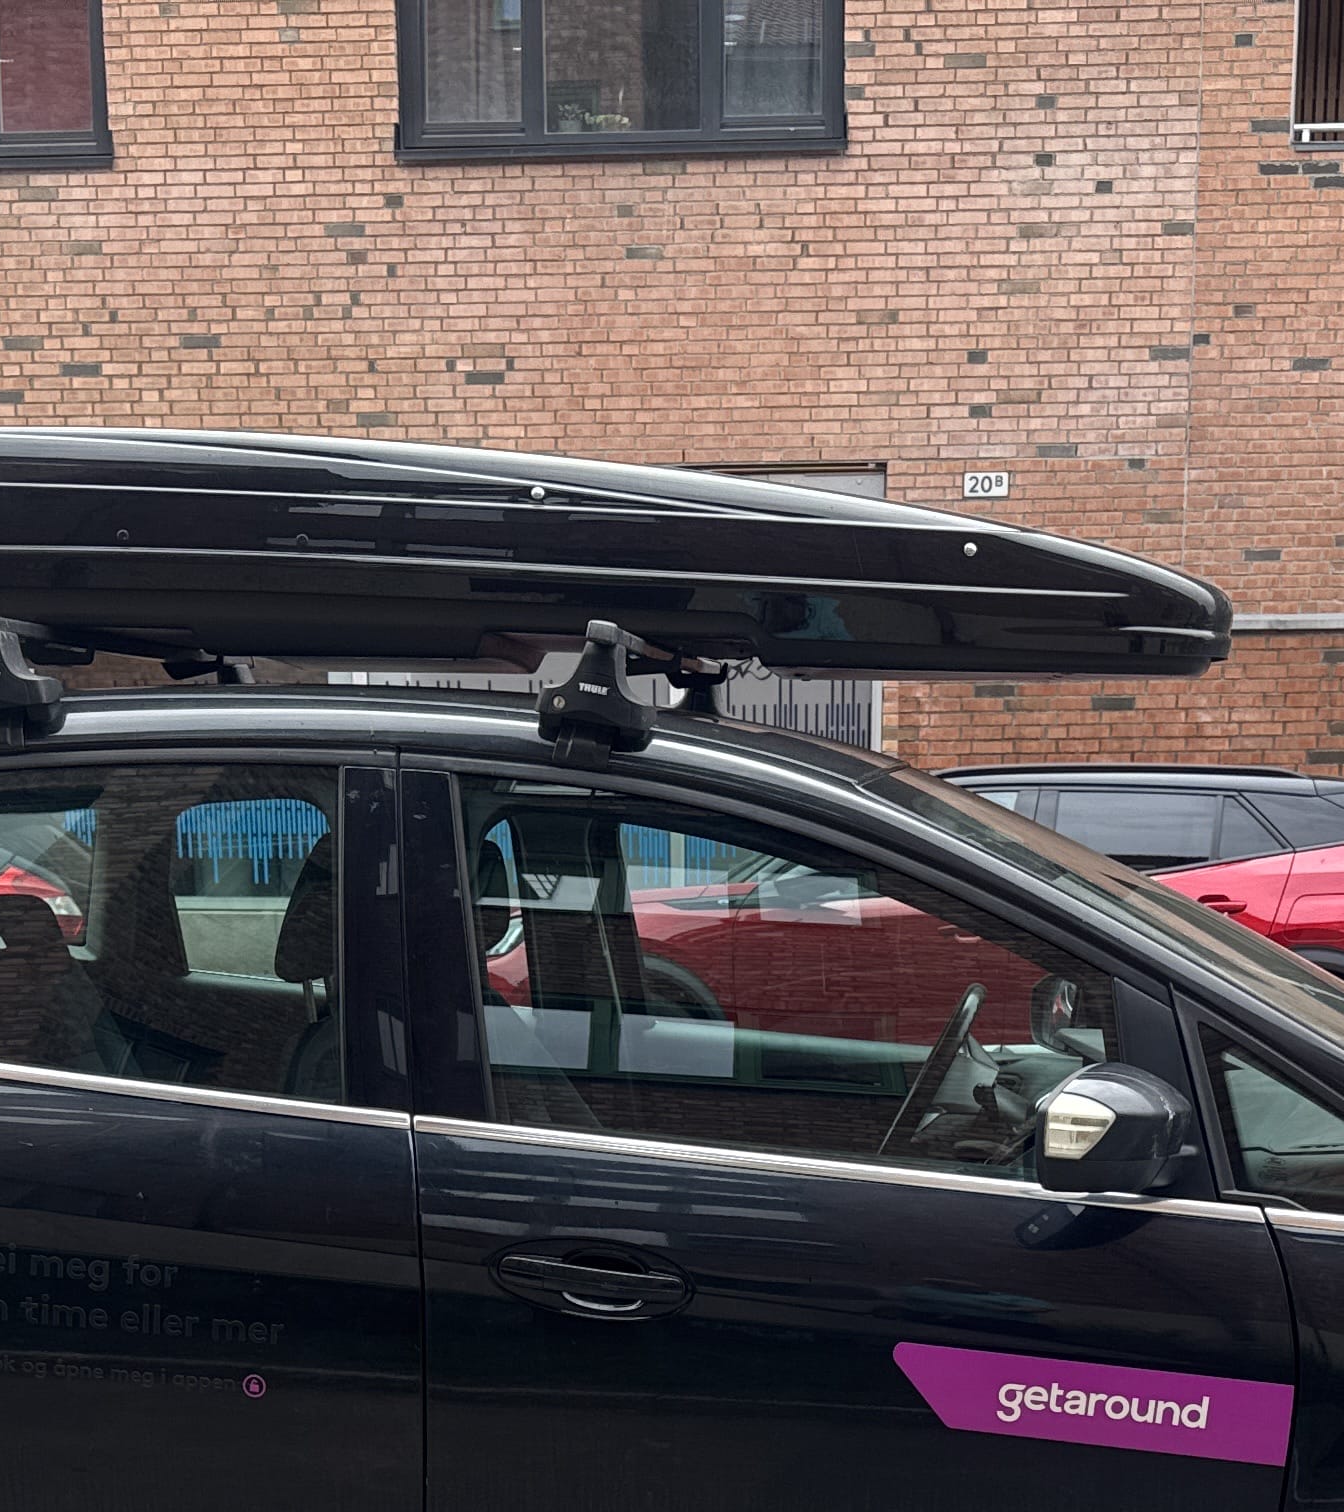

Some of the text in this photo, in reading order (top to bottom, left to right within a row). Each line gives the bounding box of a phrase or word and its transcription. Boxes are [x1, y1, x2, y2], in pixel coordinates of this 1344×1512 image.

[968, 475, 1004, 493] 20B
[579, 682, 608, 696] THULE
[30, 1253, 111, 1292] meg
[122, 1254, 179, 1288] for
[20, 1293, 109, 1330] time
[121, 1303, 199, 1338] eller
[211, 1317, 286, 1346] mer
[22, 1359, 48, 1378] og
[56, 1358, 105, 1382] åpne
[110, 1367, 155, 1388] meg
[172, 1372, 236, 1394] appen
[996, 1381, 1209, 1431] getaround
